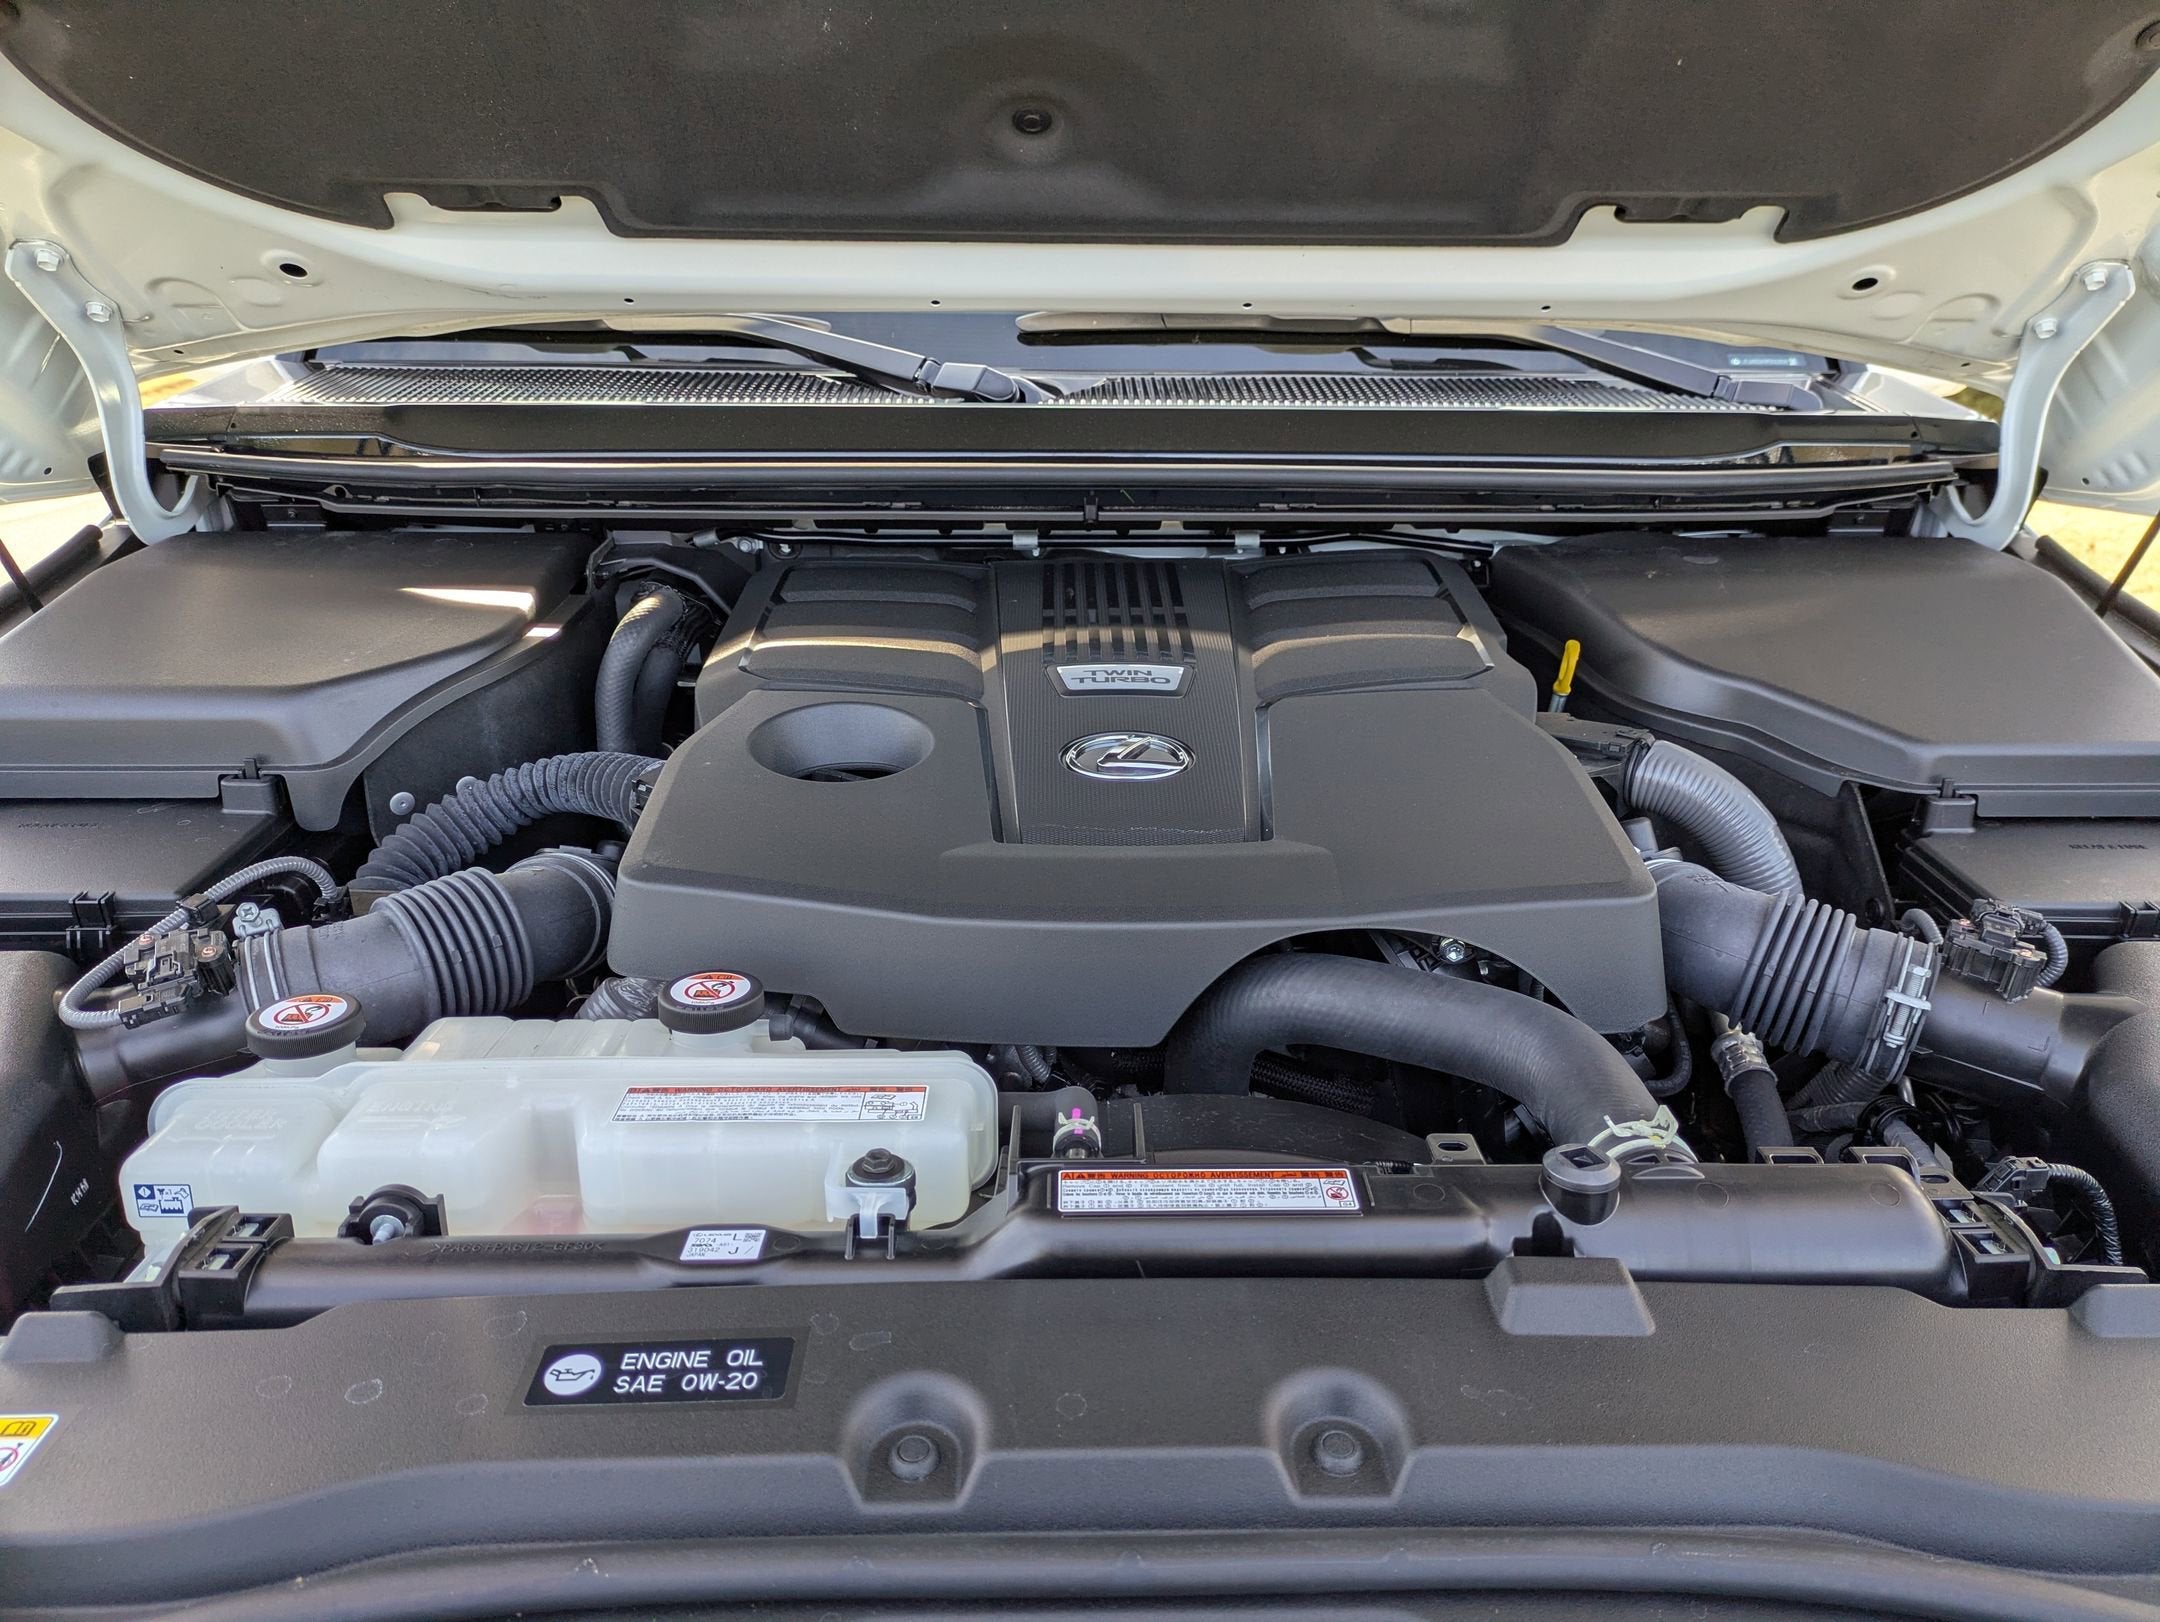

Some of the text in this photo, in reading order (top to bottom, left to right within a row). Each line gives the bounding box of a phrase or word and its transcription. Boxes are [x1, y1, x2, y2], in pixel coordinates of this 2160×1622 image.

[1071, 676, 1171, 684] TURBO
[732, 1233, 742, 1241] L
[728, 1246, 739, 1255] J
[620, 1349, 764, 1371] ENGINE OIL
[613, 1372, 758, 1393] SAE 0W-20
